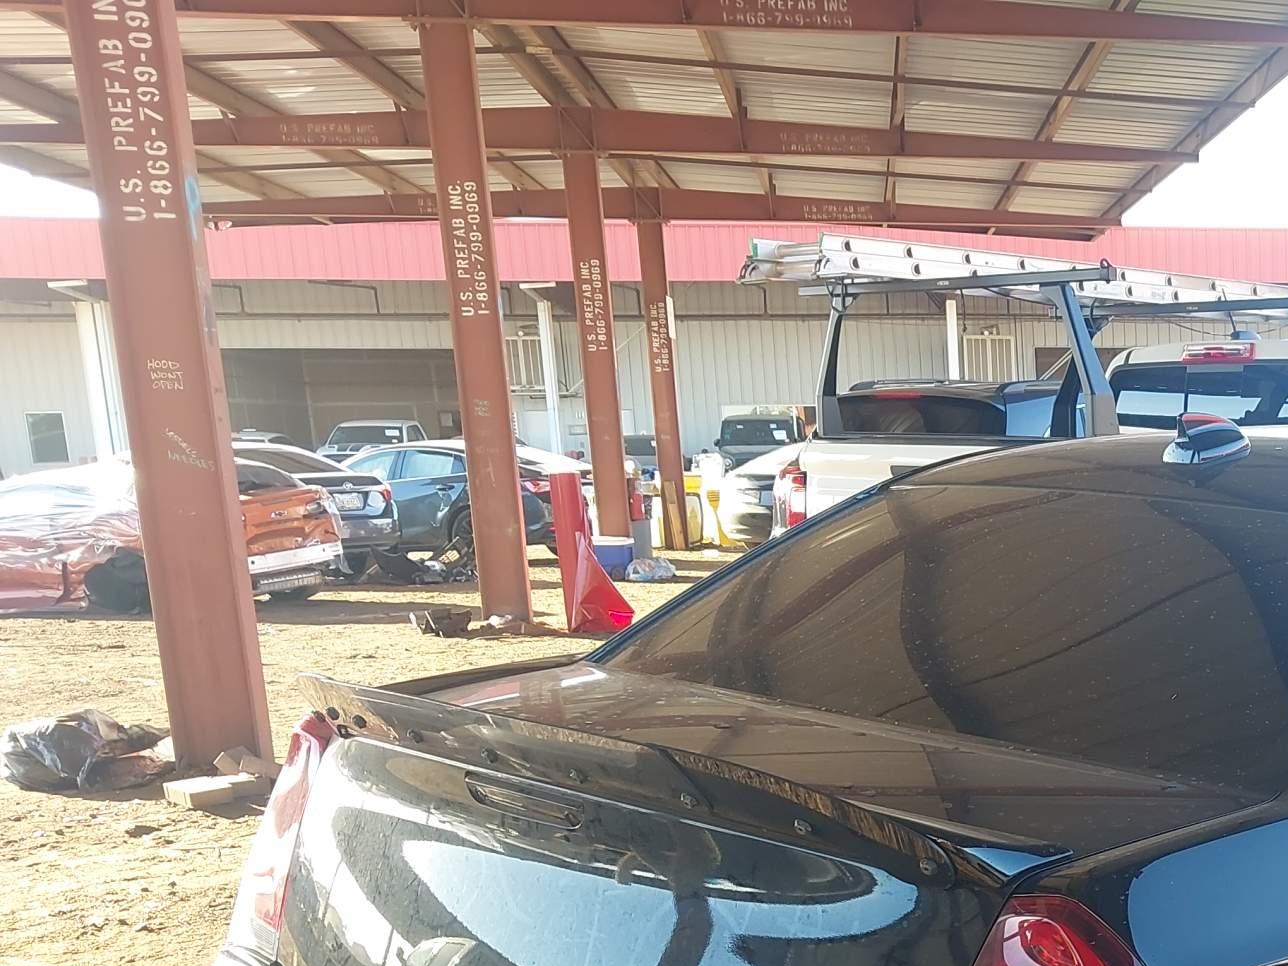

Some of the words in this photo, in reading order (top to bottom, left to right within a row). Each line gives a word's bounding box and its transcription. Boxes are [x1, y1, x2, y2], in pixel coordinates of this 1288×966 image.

[98, 39, 138, 151] PREFAB
[120, 170, 147, 221] U.S.
[448, 180, 463, 210] INC.
[452, 218, 471, 278] PREFAB
[464, 181, 490, 314] 1-866-799-0969
[460, 287, 475, 316] U.S.
[582, 284, 595, 326] PREFAB
[650, 321, 660, 353] PREFAB
[147, 359, 180, 369] HOOD
[150, 370, 184, 380] WONT
[152, 379, 184, 391] OPEN
